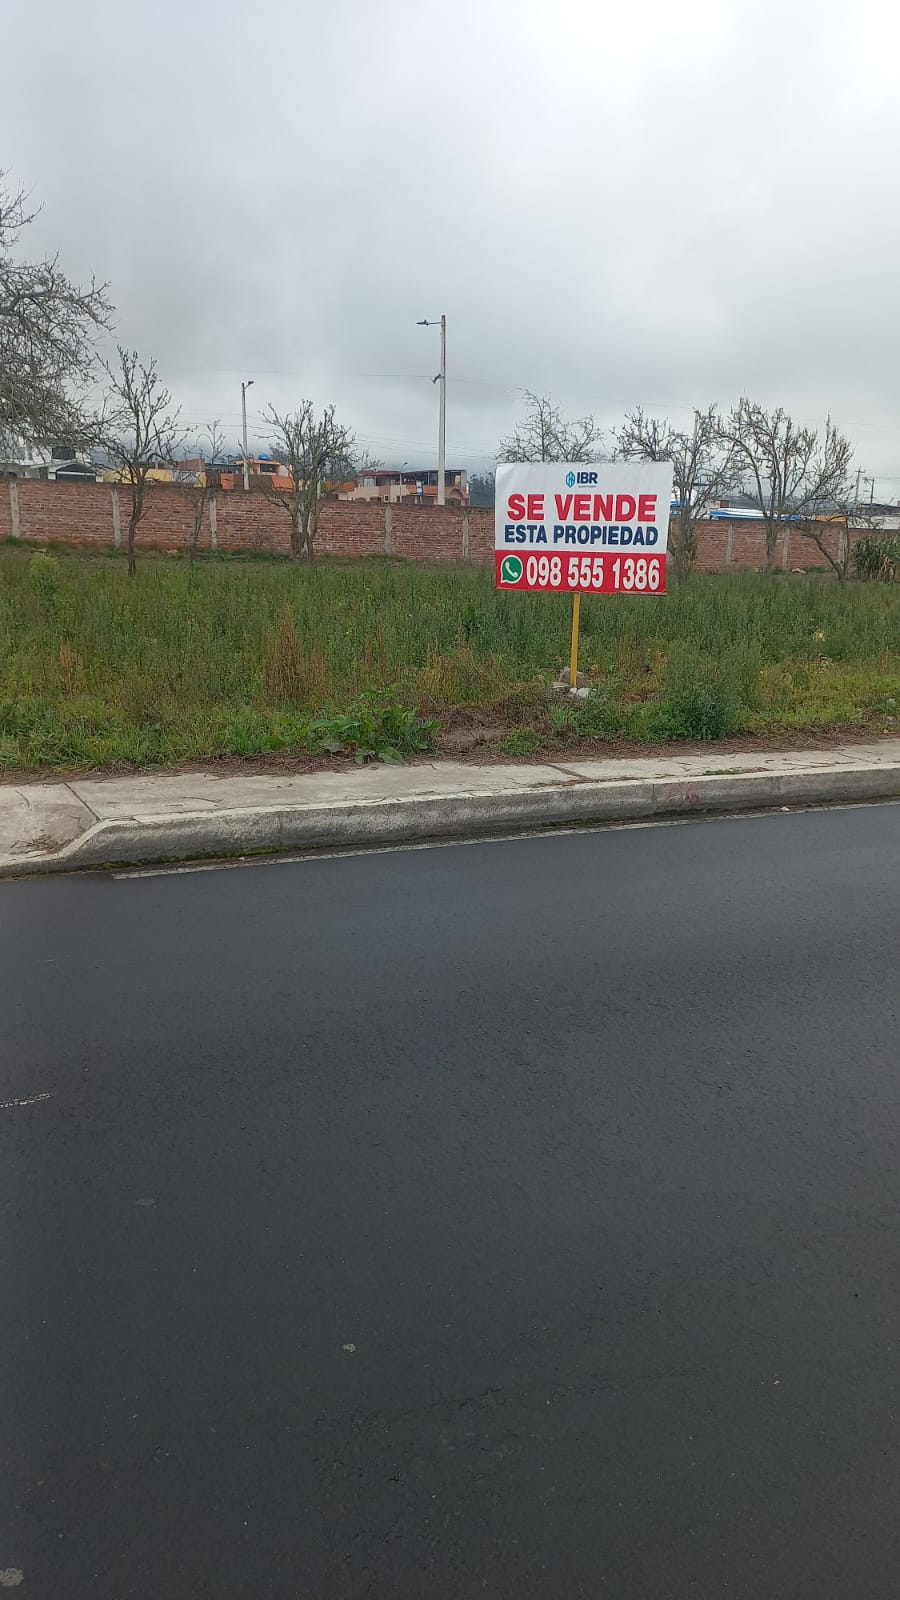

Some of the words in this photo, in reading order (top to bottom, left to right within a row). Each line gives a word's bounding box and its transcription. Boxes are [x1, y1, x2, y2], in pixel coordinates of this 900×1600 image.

[577, 472, 598, 484] IBR
[507, 493, 545, 521] SE
[554, 494, 658, 522] VENDE
[504, 525, 547, 543] ESTA
[553, 525, 659, 546] PROPIEDAD
[526, 555, 562, 586] 098
[567, 557, 604, 588] 555
[612, 557, 660, 590] 1386
